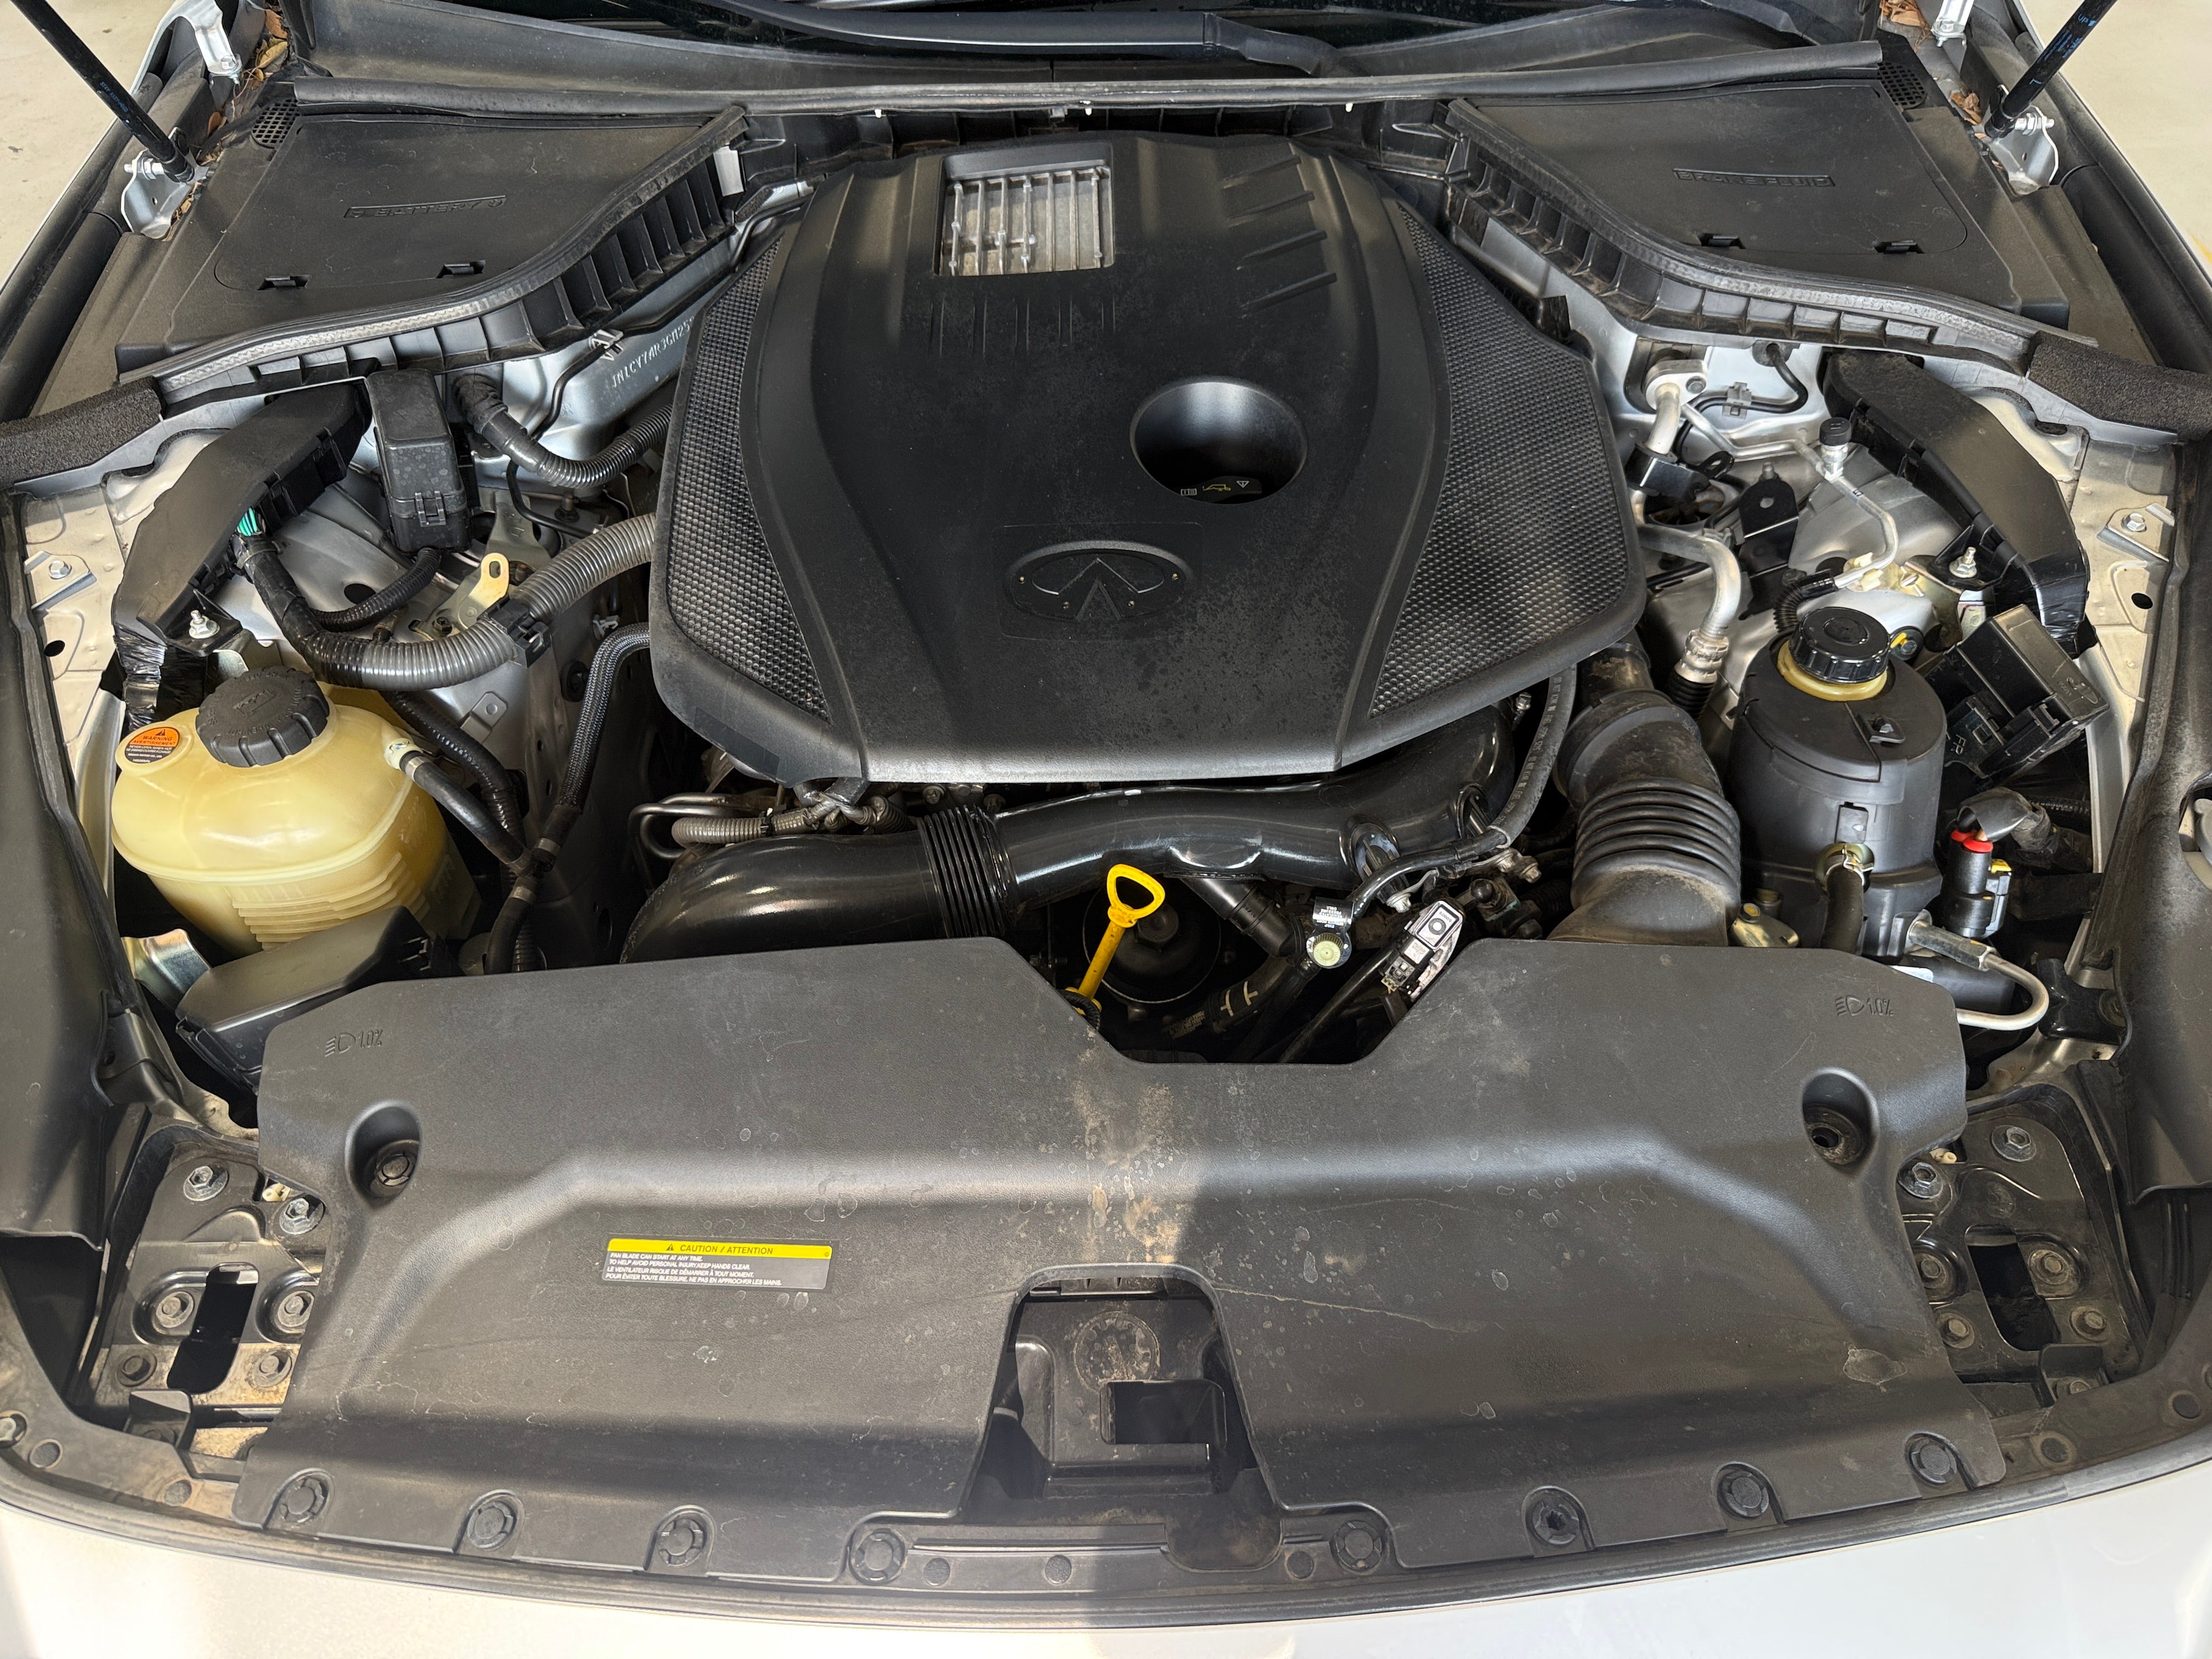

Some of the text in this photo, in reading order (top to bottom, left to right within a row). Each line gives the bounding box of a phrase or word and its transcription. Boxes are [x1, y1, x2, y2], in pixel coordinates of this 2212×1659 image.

[374, 200, 482, 217] BATTERY
[680, 1244, 717, 1252] CAUTION
[726, 1246, 774, 1255] ATTENTION
[621, 1272, 641, 1280] ÉVITER
